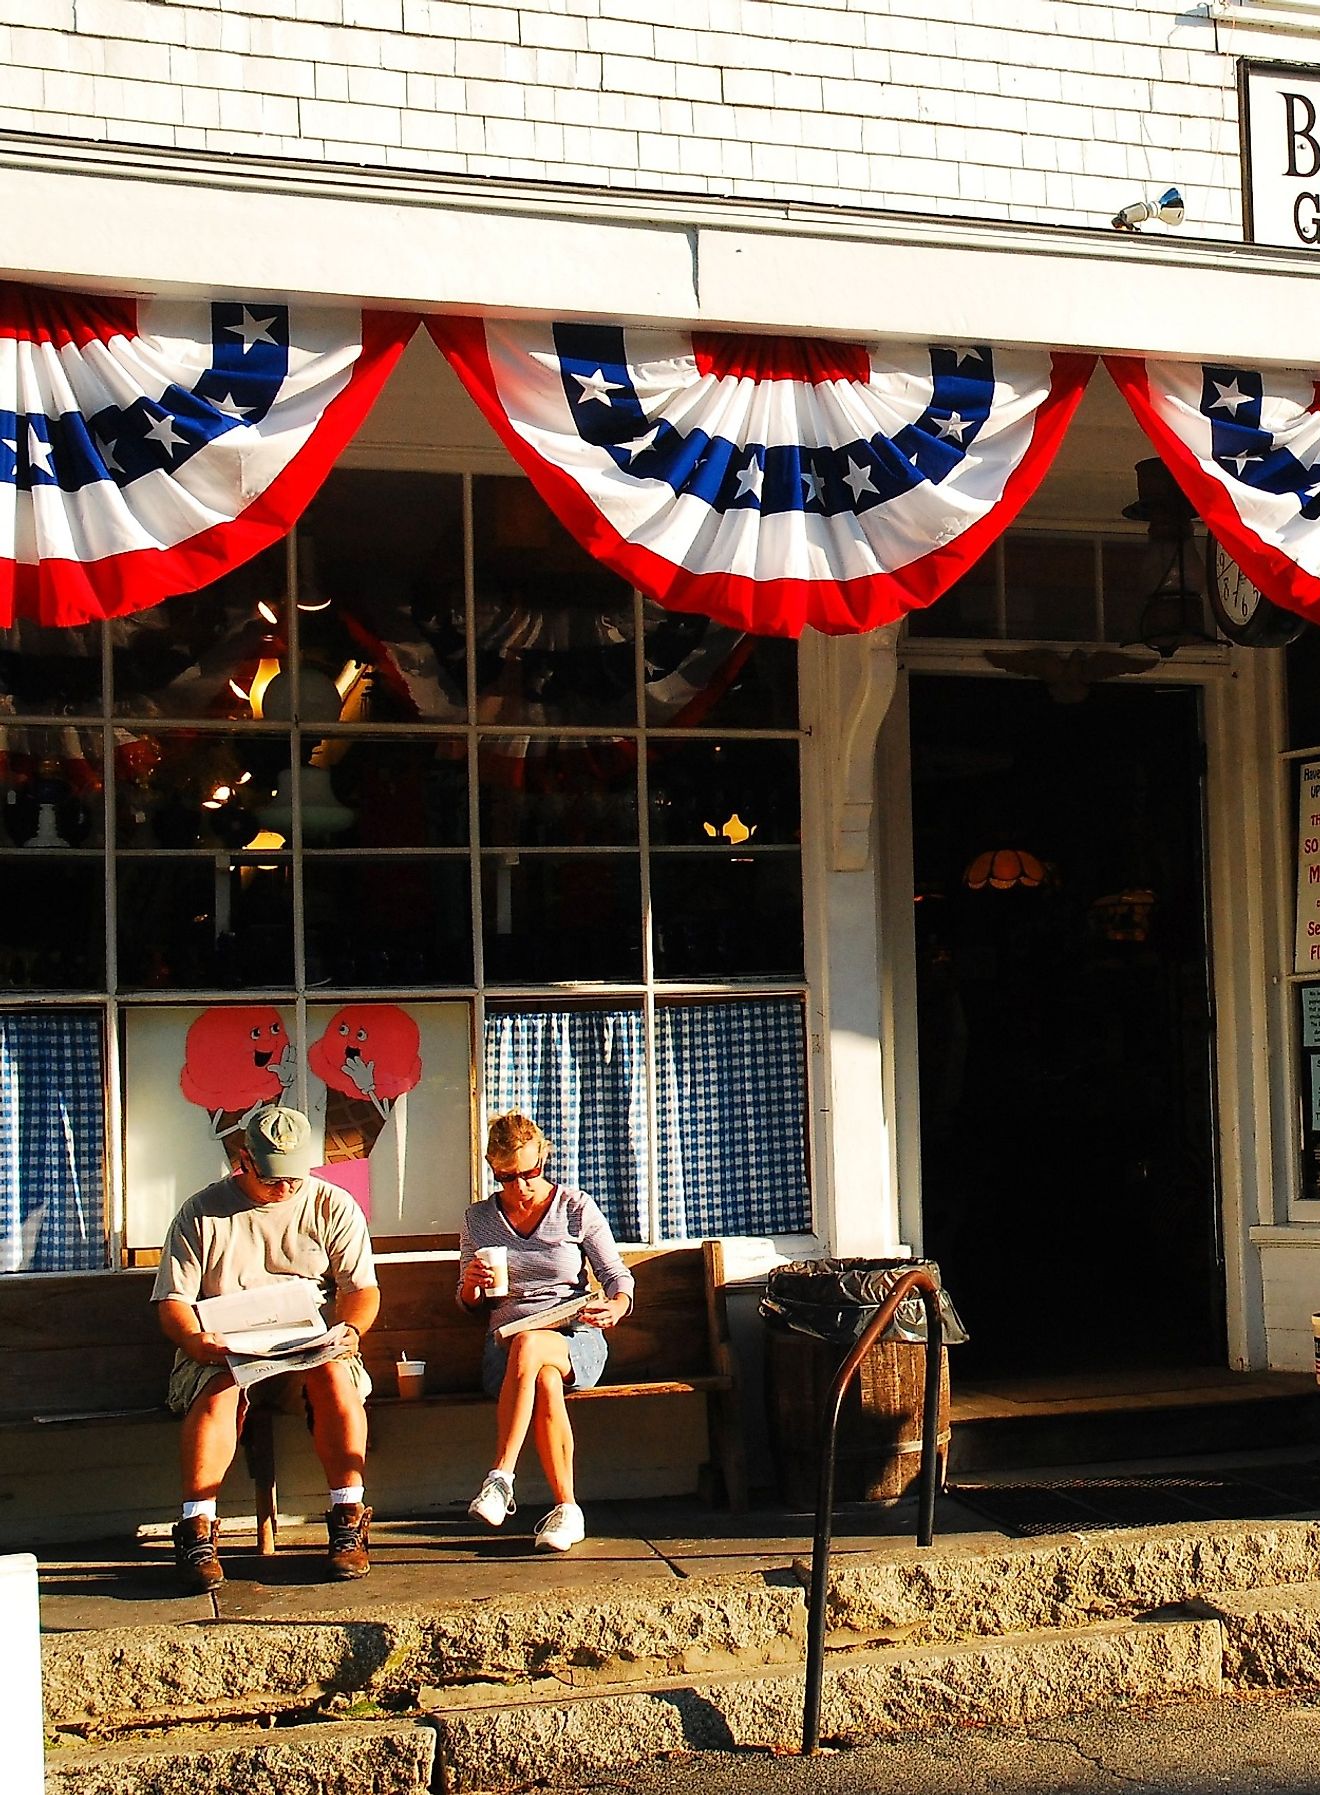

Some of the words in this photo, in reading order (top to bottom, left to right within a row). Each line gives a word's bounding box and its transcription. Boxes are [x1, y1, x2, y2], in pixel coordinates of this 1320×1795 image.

[1241, 594, 1248, 617] 6
[1303, 768, 1320, 782] Have
[1304, 838, 1319, 854] SO
